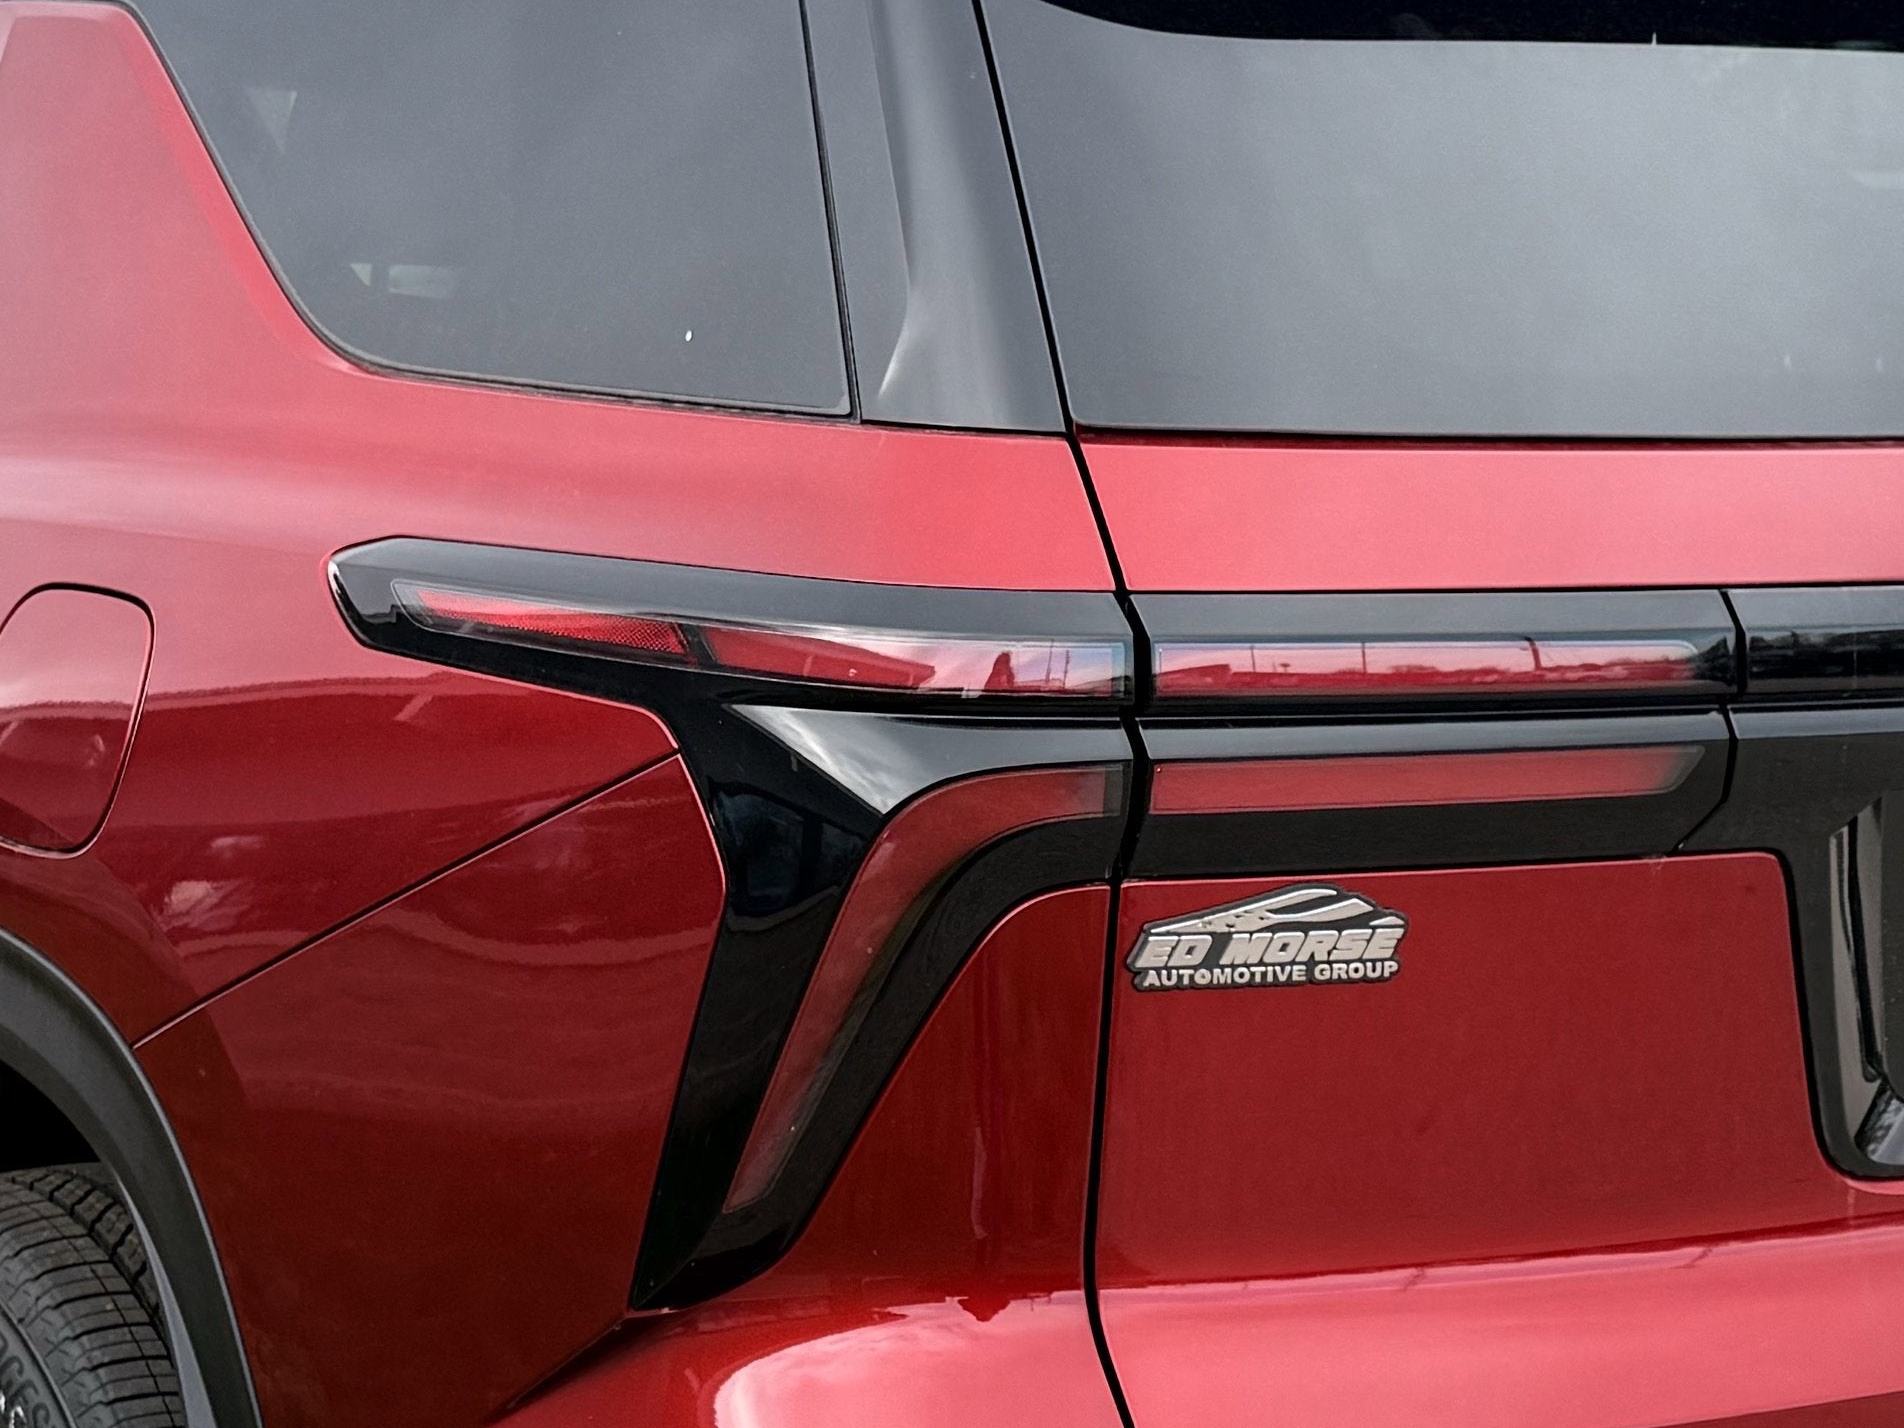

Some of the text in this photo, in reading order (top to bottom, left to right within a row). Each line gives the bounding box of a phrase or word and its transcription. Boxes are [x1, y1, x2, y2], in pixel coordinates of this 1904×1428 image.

[1135, 928, 1405, 968] ED MORSE
[1142, 960, 1399, 987] AUTOMOTIVE GROUP
